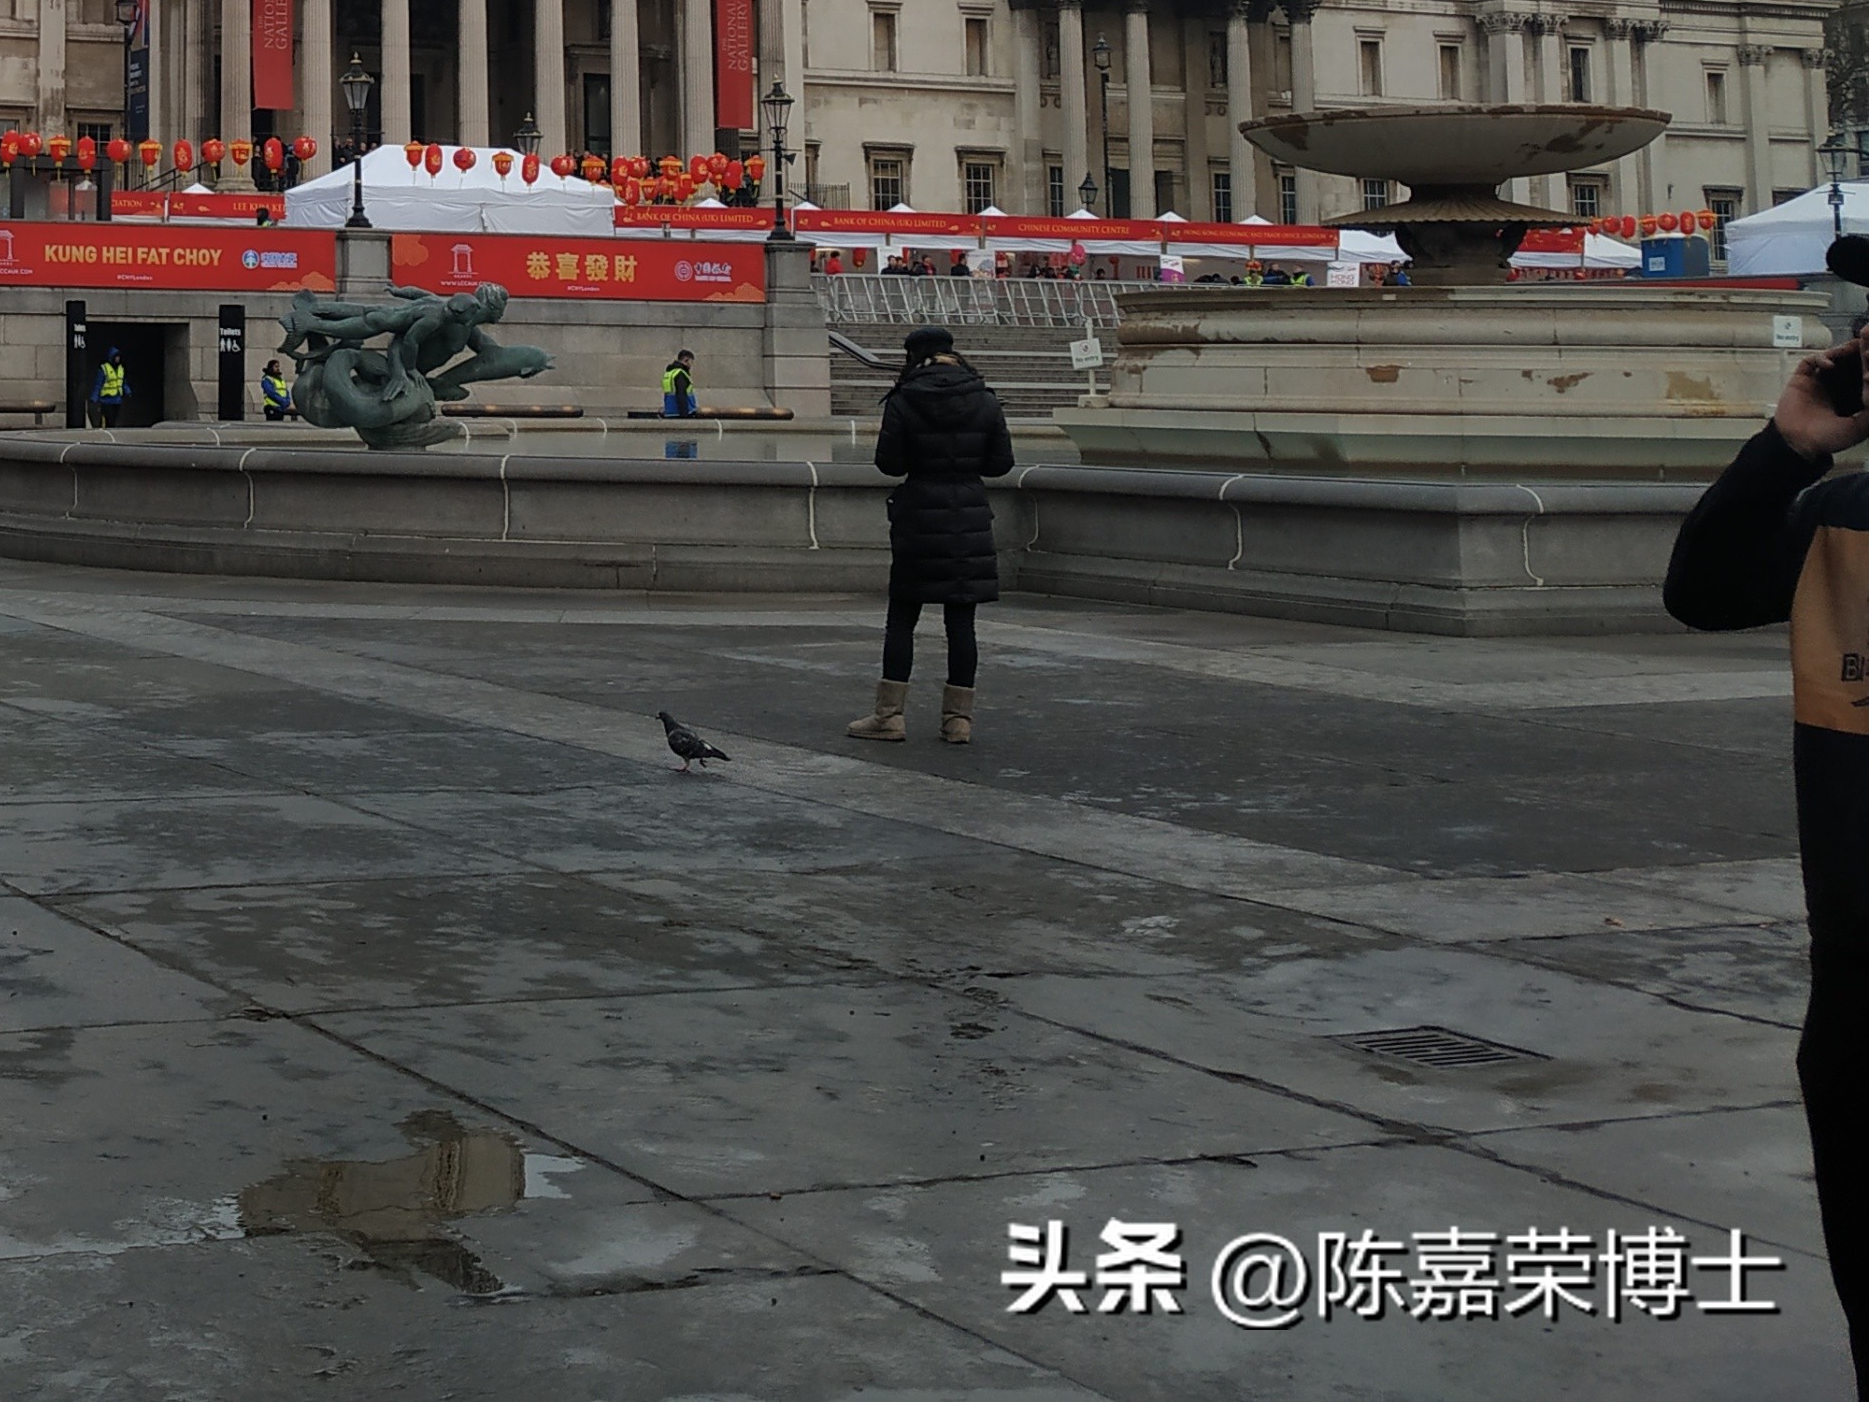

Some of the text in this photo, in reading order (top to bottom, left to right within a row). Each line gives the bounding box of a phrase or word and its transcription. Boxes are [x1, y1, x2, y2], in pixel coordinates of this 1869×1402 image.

[727, 2, 737, 70] NATIONAL
[737, 1, 749, 71] GALLERY
[637, 212, 659, 221] BANK
[673, 214, 701, 222] CHINA
[720, 214, 753, 224] LIMITED
[834, 217, 947, 228] BANK OF CHINA (UK) LIMITED
[1018, 224, 1130, 235] CHINESE COMMUNITY CENTRE
[45, 245, 222, 267] KUNG HEI FAT CHOY
[526, 251, 638, 283] 恭喜發財
[220, 328, 242, 336] Toilets
